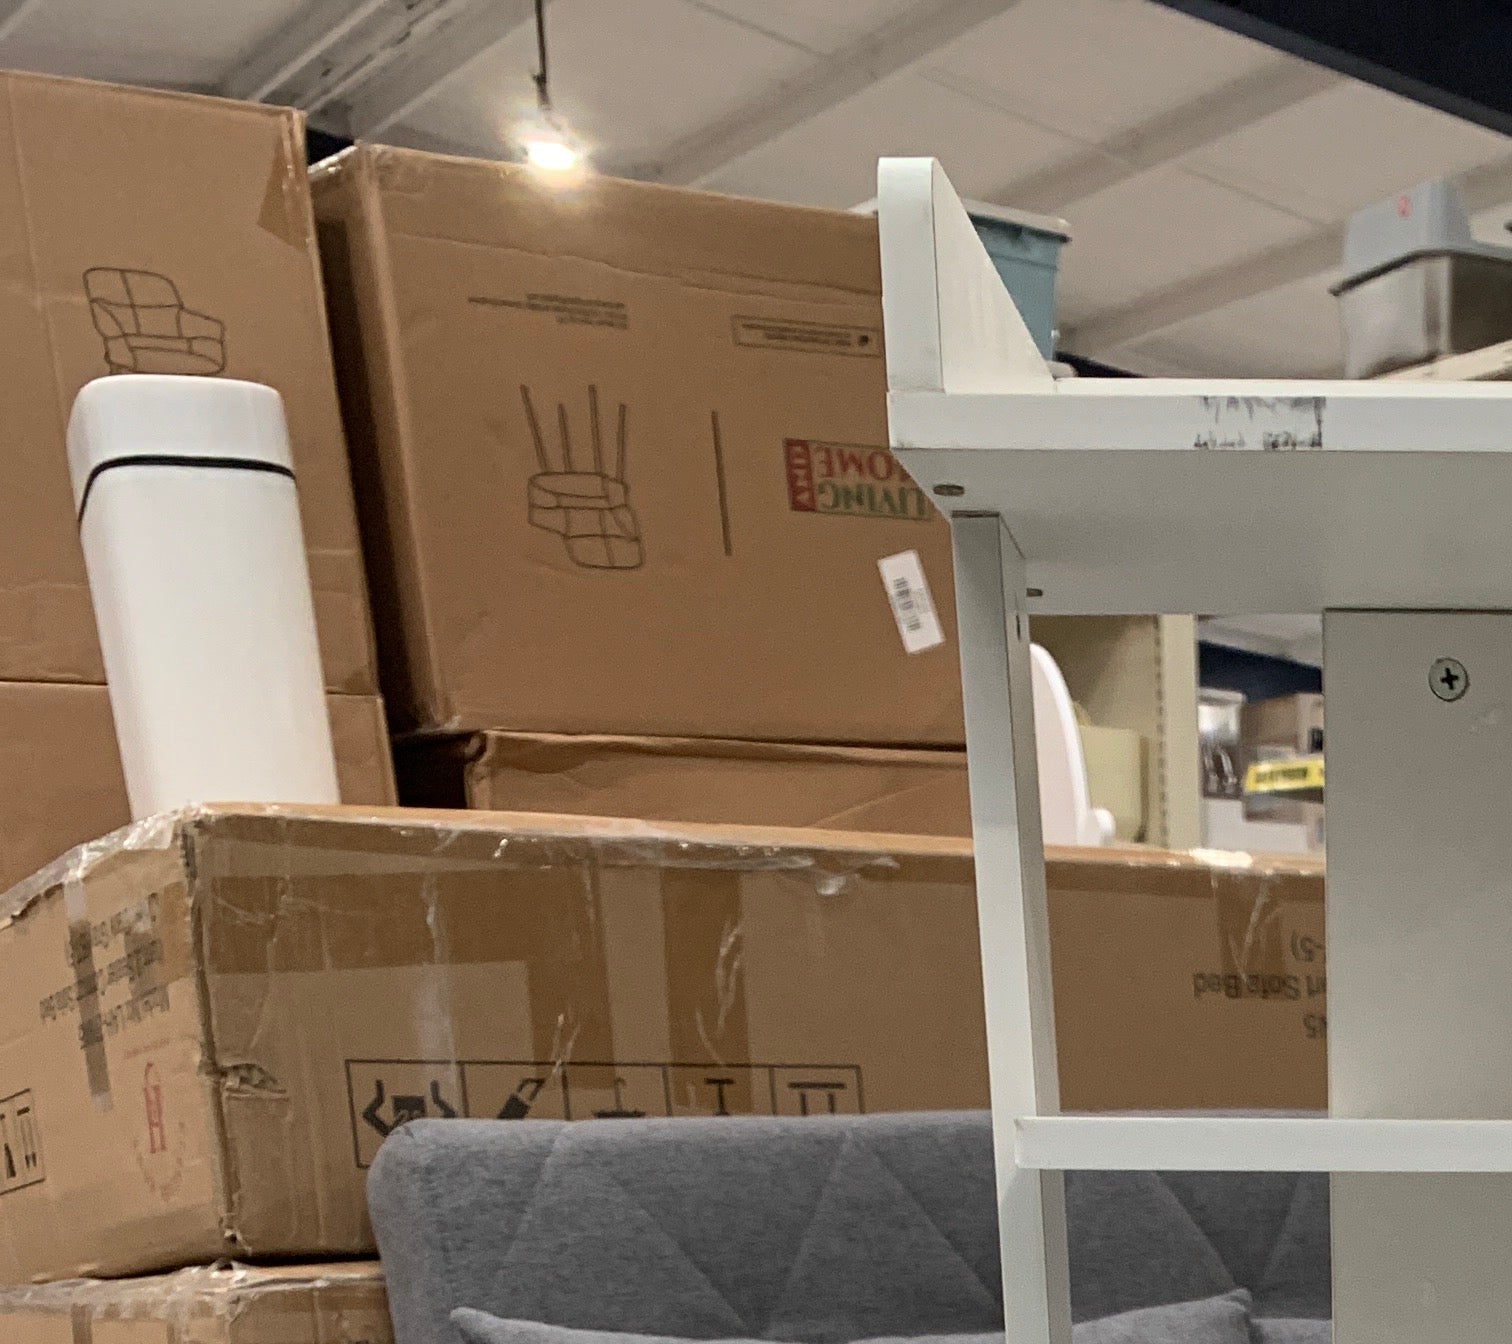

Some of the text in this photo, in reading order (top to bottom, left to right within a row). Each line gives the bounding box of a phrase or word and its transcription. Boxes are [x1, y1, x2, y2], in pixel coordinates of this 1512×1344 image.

[815, 446, 911, 482] OME
[1193, 973, 1242, 1000] Bed
[1246, 974, 1301, 1000] Sofa
